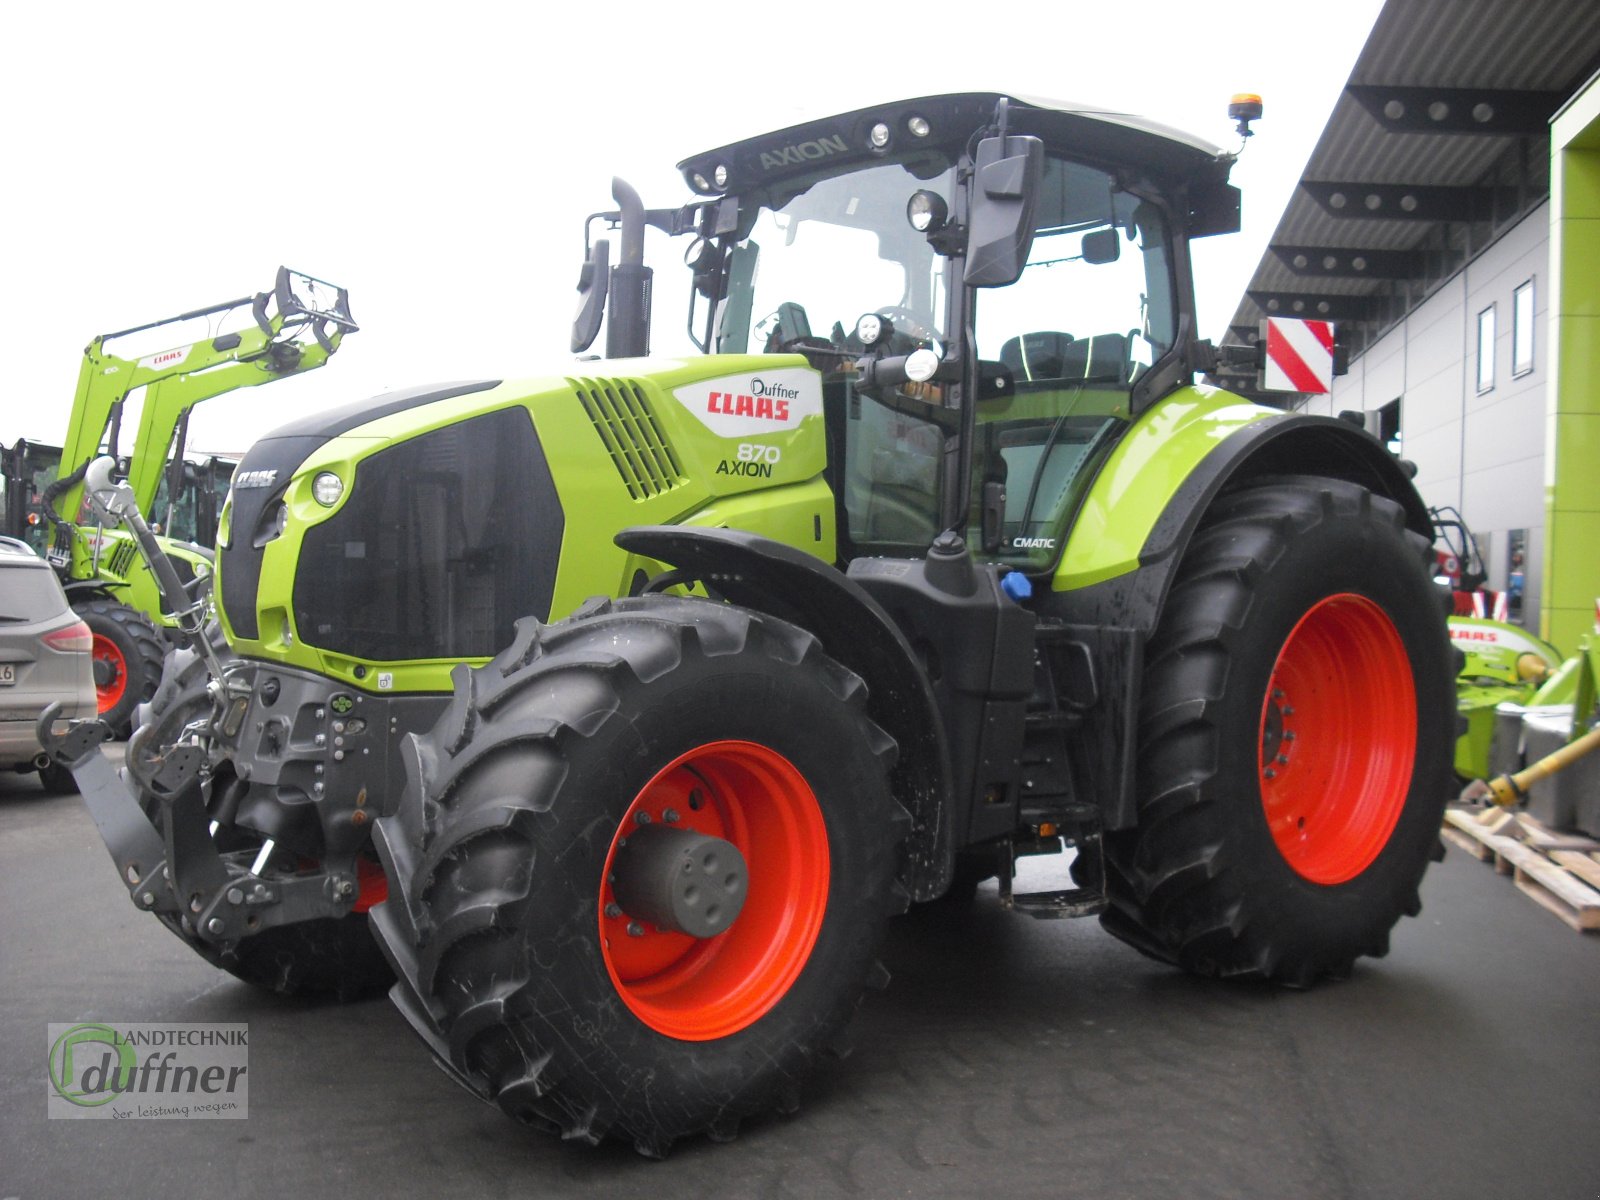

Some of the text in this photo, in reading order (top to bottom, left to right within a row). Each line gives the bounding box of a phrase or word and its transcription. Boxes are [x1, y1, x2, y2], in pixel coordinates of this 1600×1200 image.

[760, 134, 849, 170] AXION
[750, 377, 800, 400] Duffner
[707, 391, 789, 422] CLAAS
[737, 443, 781, 464] 870
[715, 459, 772, 478] AXION
[1012, 537, 1056, 549] CMATIC
[0, 665, 12, 681] 6
